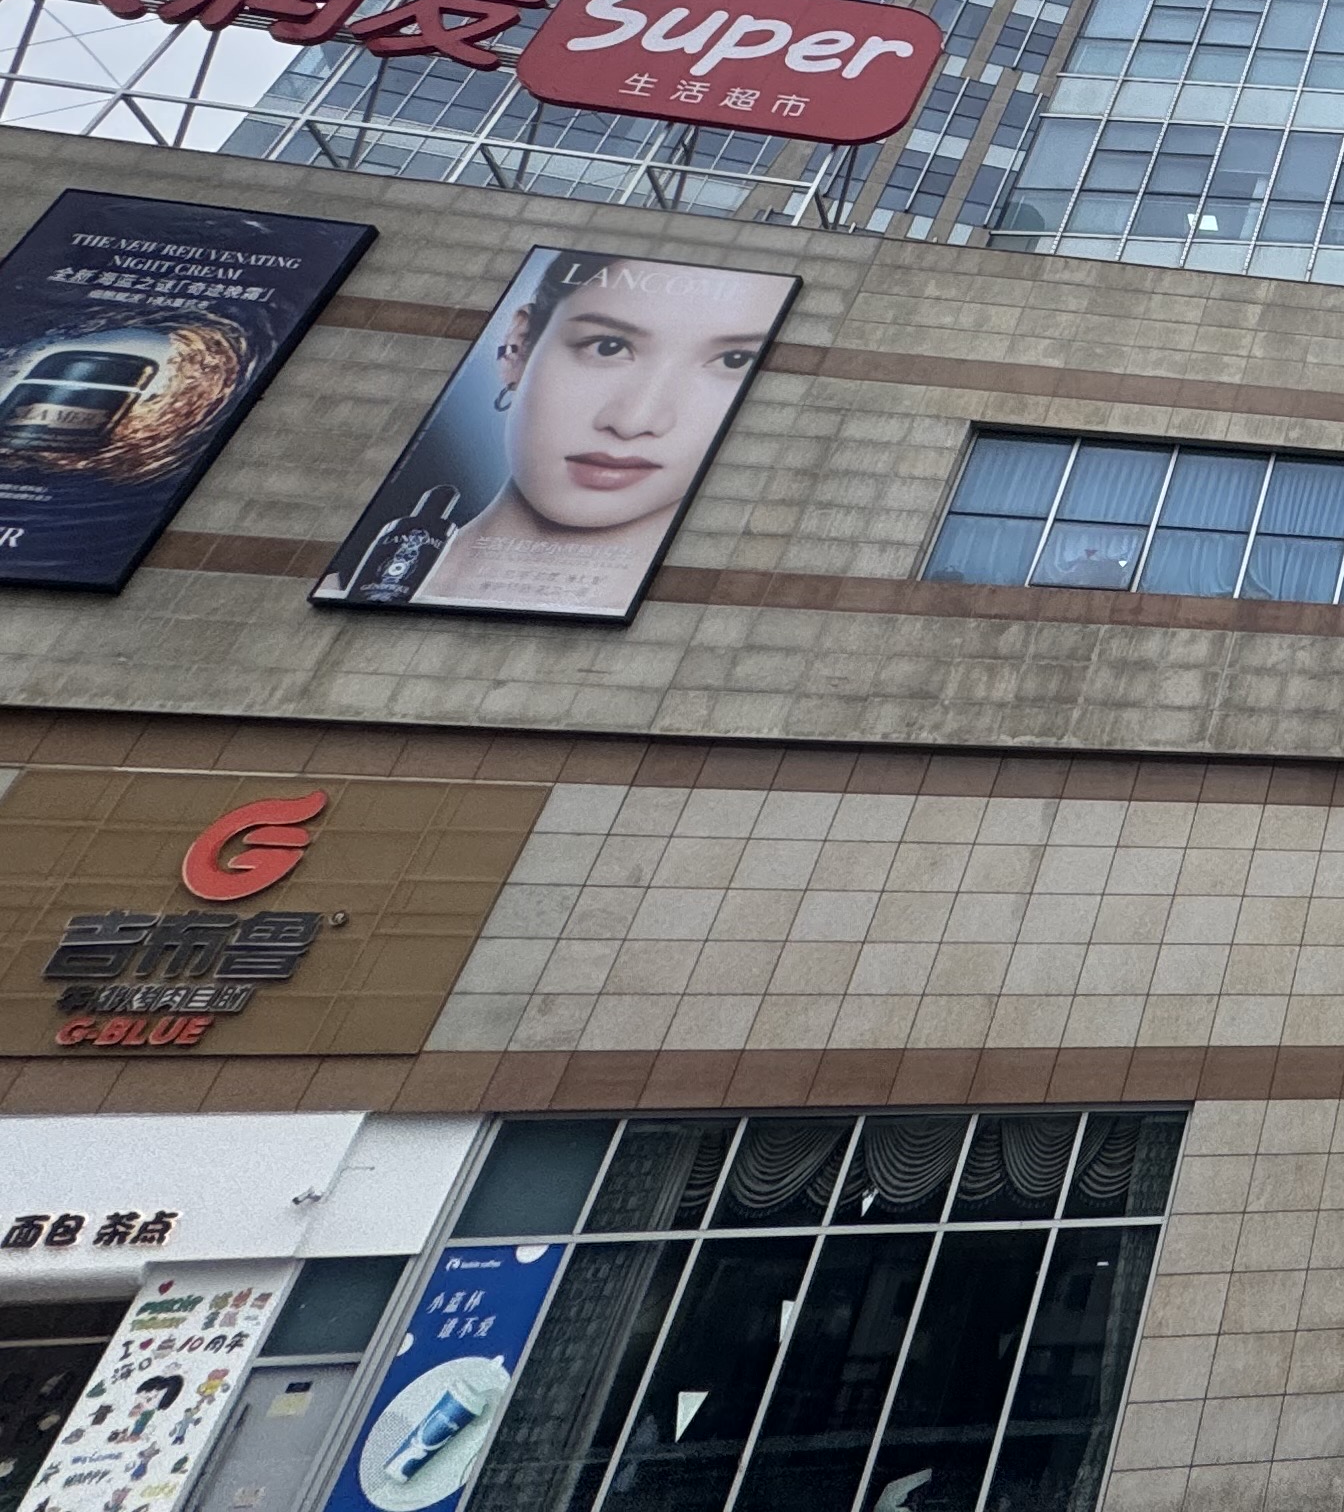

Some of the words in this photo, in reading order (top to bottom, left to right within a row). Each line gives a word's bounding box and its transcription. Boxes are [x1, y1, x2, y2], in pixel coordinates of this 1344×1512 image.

[618, 72, 811, 117] 生活超市
[71, 233, 112, 248] THE
[112, 236, 160, 252] NEW
[158, 242, 302, 270] REJUVENATING
[108, 254, 176, 273] NIGHT
[174, 262, 244, 281] CREAM
[41, 910, 325, 979] 吉布鲁
[56, 1012, 214, 1047] G-BLUE
[0, 1213, 86, 1249] 面包
[92, 1210, 179, 1246] 茶点
